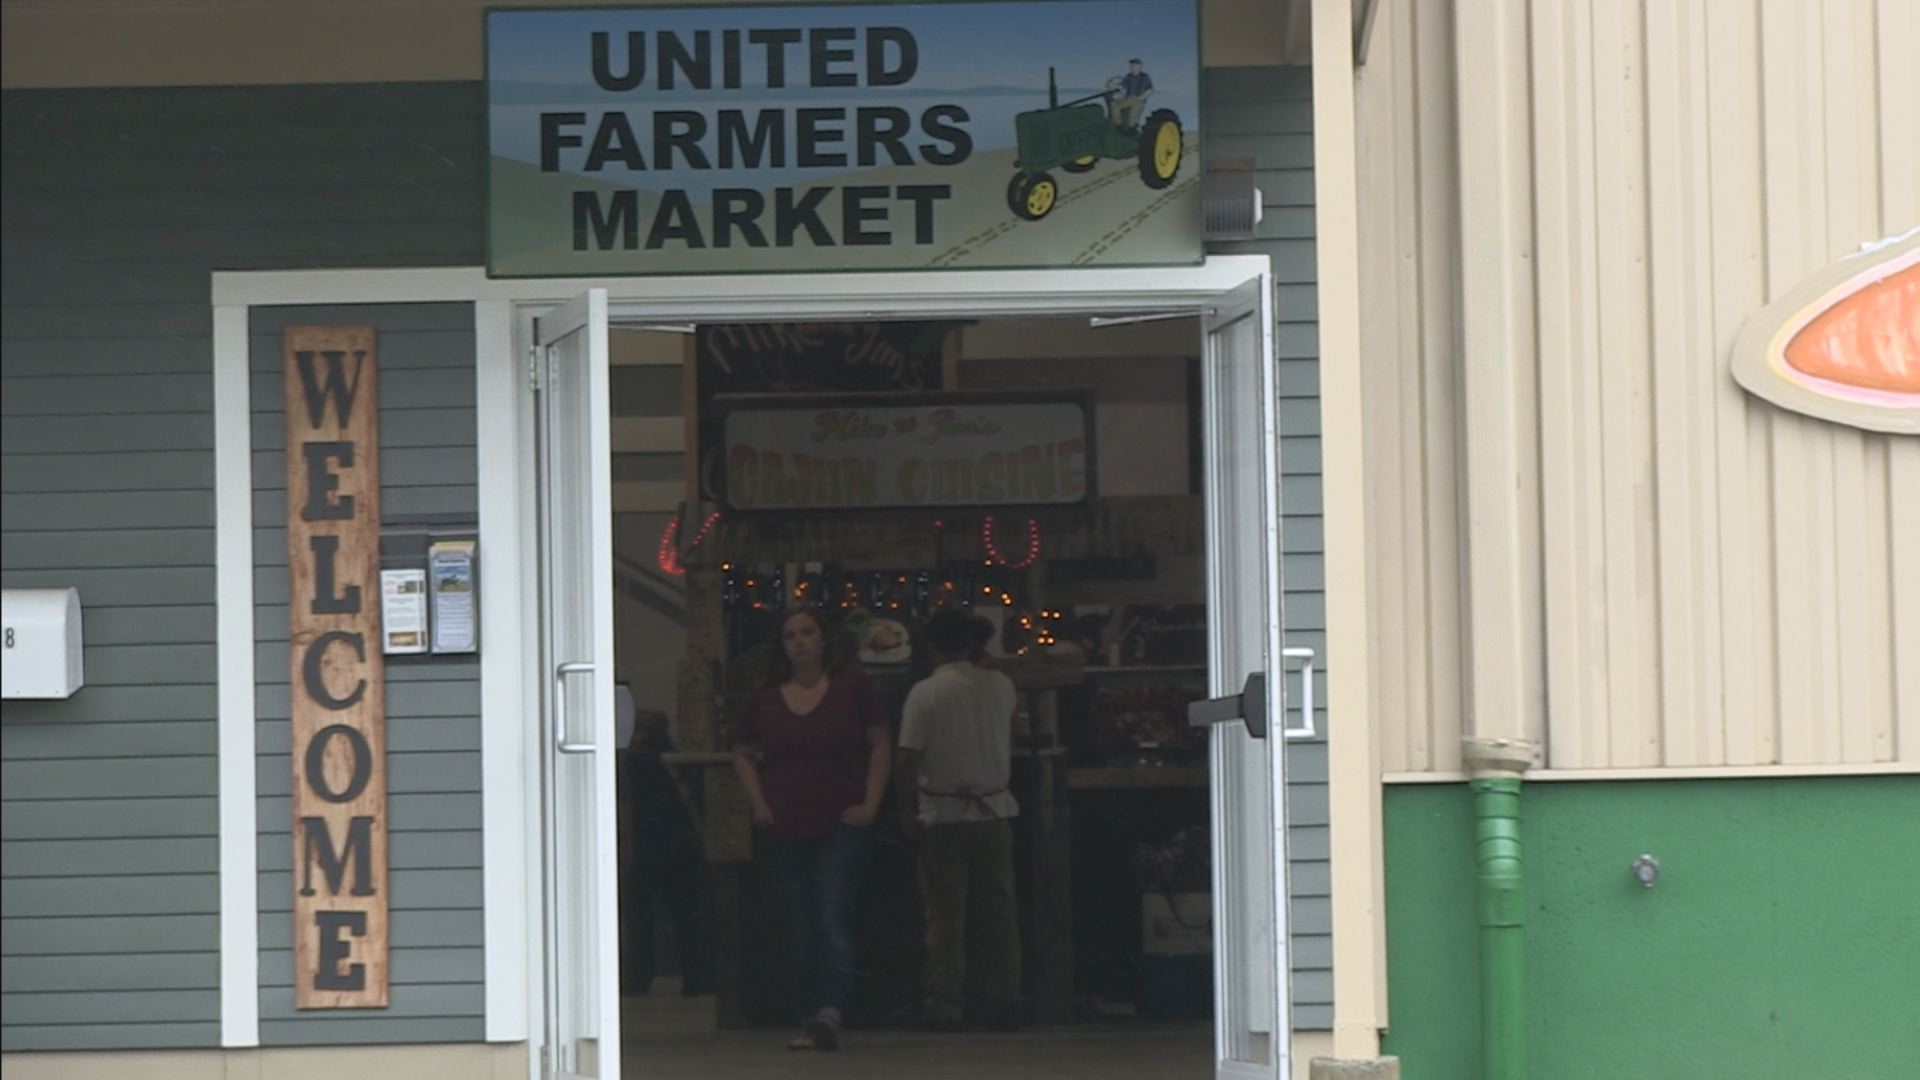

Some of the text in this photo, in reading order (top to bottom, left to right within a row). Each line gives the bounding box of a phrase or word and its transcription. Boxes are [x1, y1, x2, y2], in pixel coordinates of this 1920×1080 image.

[590, 26, 919, 92] UNITED
[539, 104, 973, 172] FARMERS
[572, 184, 951, 251] MARKET
[730, 438, 1086, 507] CAJUN CUISINE
[5, 627, 15, 649] 8
[293, 350, 376, 991] WELCOME
